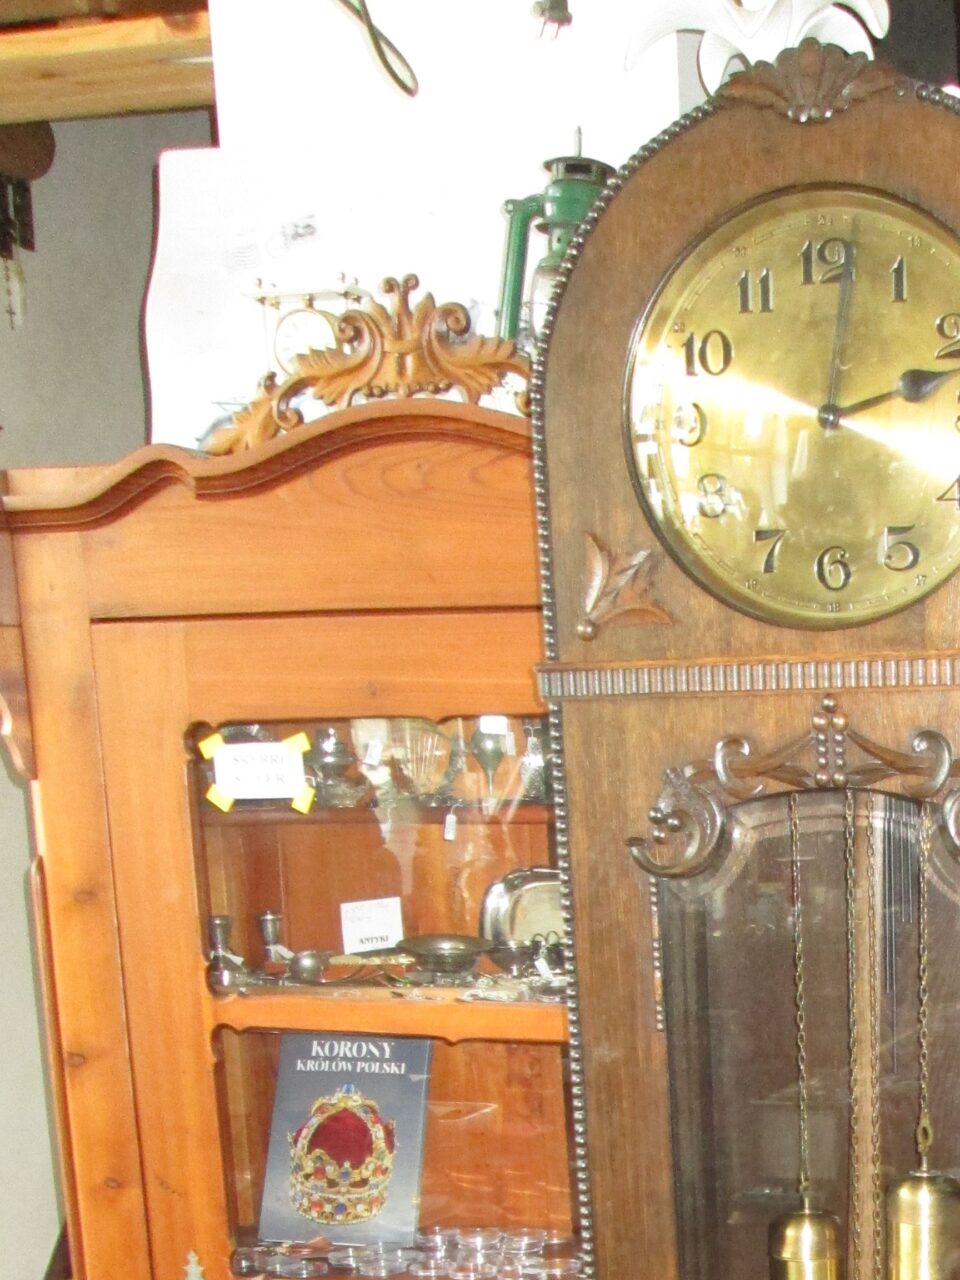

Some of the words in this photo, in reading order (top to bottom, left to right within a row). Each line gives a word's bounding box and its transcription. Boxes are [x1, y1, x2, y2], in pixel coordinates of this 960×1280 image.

[798, 237, 857, 285] 12
[889, 255, 908, 303] 1
[736, 267, 775, 314] 11
[681, 330, 733, 376] 10
[698, 473, 728, 519] 8
[753, 529, 786, 574] 7
[814, 545, 852, 592] 6
[882, 524, 920, 572] 5
[296, 1058, 355, 1072] KRÓLÓW
[356, 1061, 406, 1075] POLSKI
[311, 1040, 396, 1059] KORONY
